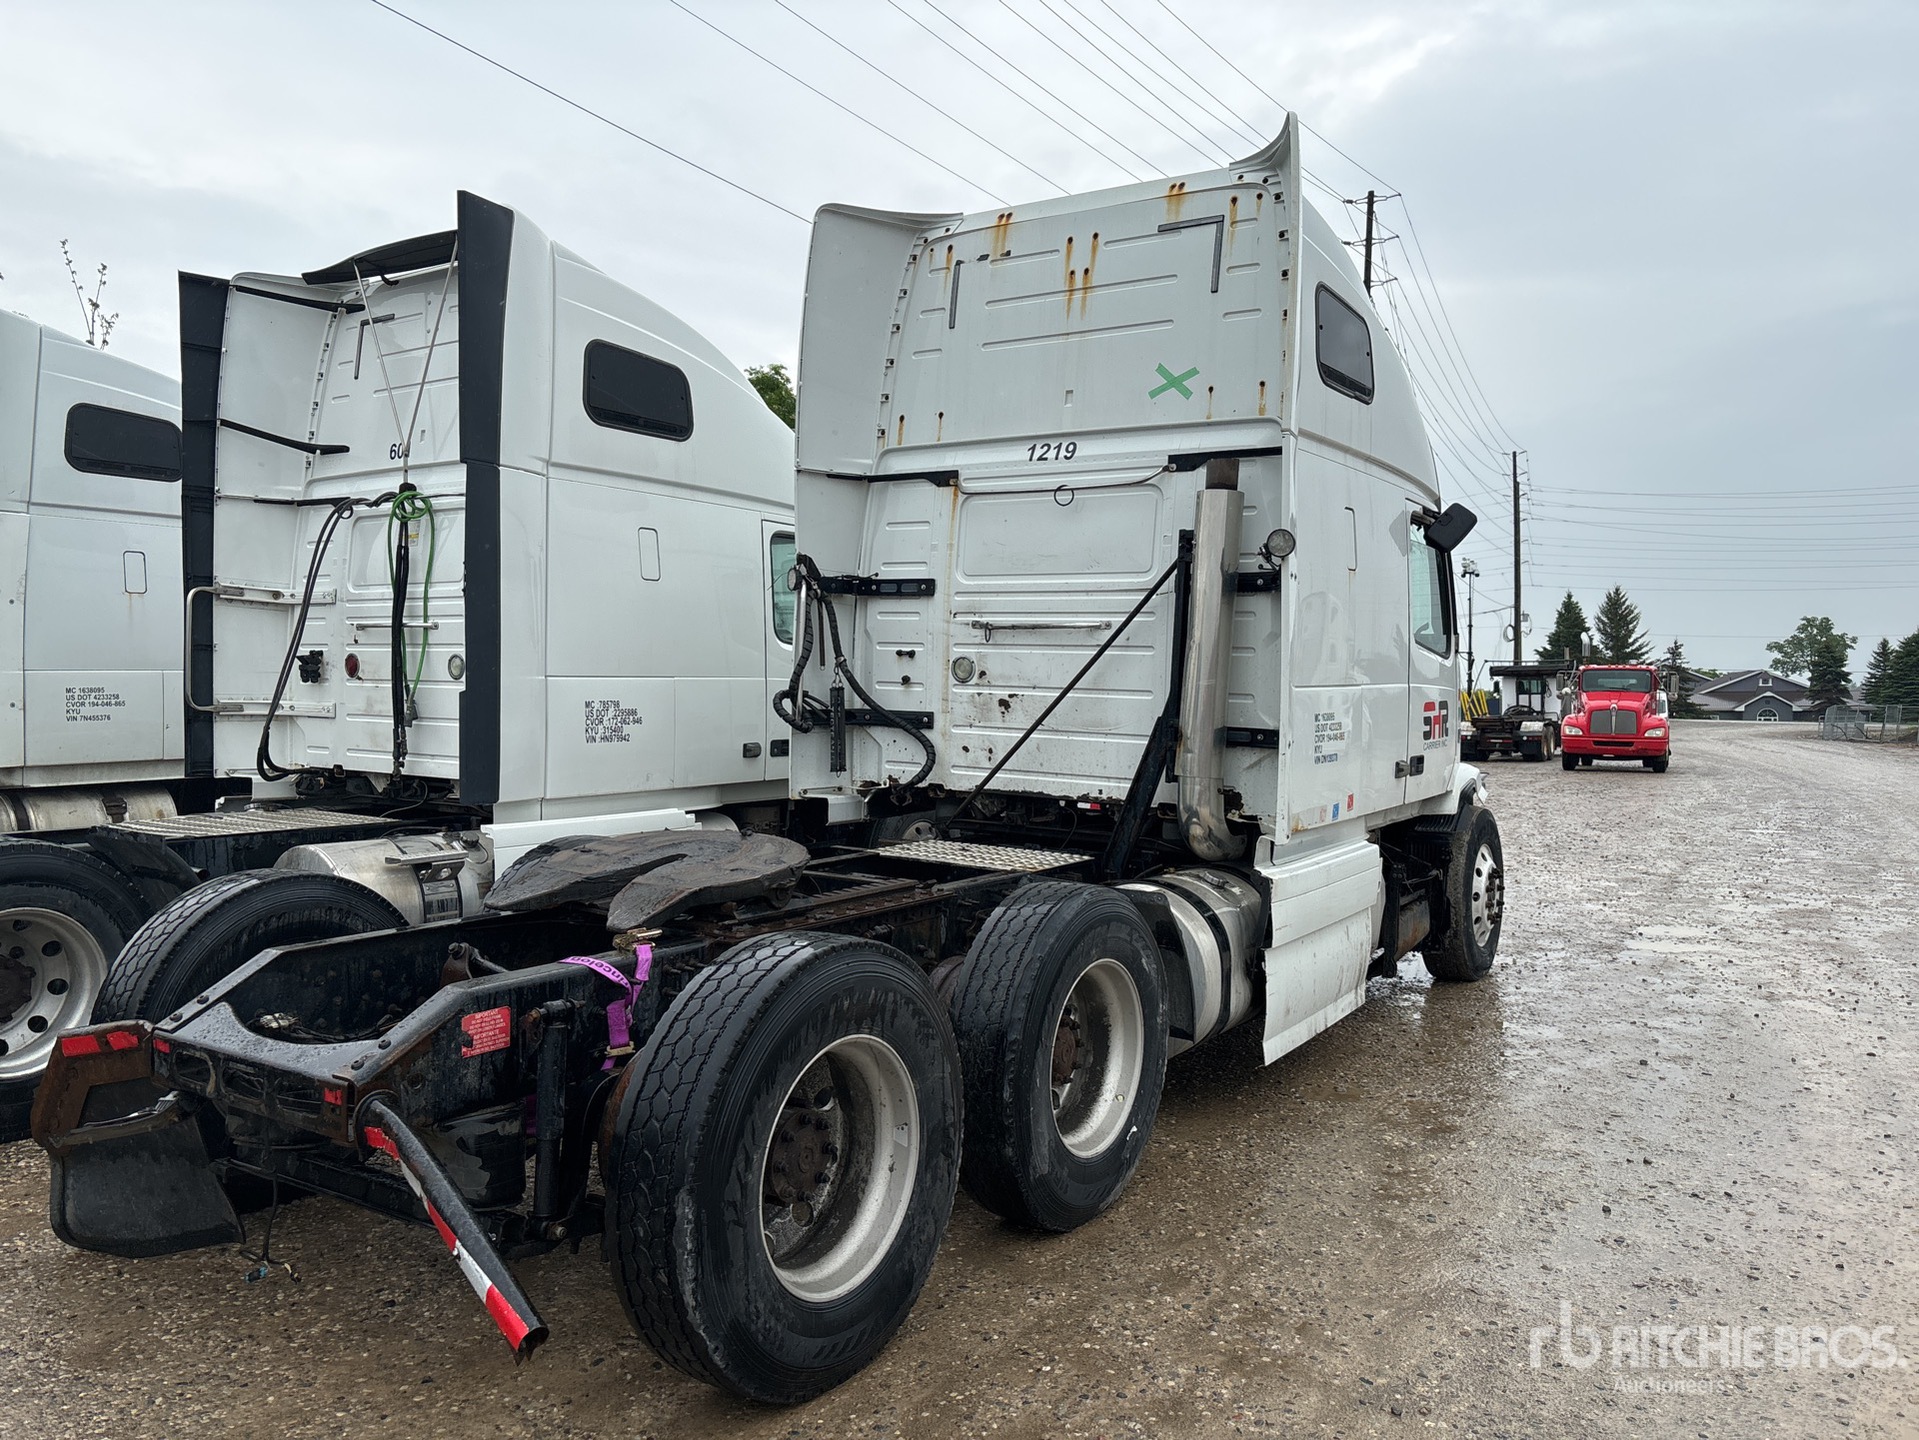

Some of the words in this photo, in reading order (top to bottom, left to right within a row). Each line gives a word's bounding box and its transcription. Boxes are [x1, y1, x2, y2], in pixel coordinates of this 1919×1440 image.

[1027, 441, 1078, 462] 1219
[93, 693, 120, 701] 4233258
[584, 700, 596, 709] MC
[584, 709, 595, 718] US
[595, 708, 609, 718] DOT
[1314, 713, 1321, 722] MC
[79, 714, 111, 722] 7N455376
[584, 717, 604, 727] CVOR
[584, 726, 600, 735] KYU
[1320, 722, 1329, 733] DOT
[584, 735, 597, 744] VIN
[1314, 733, 1326, 744] CVOR
[1423, 740, 1440, 751] CARRIER
